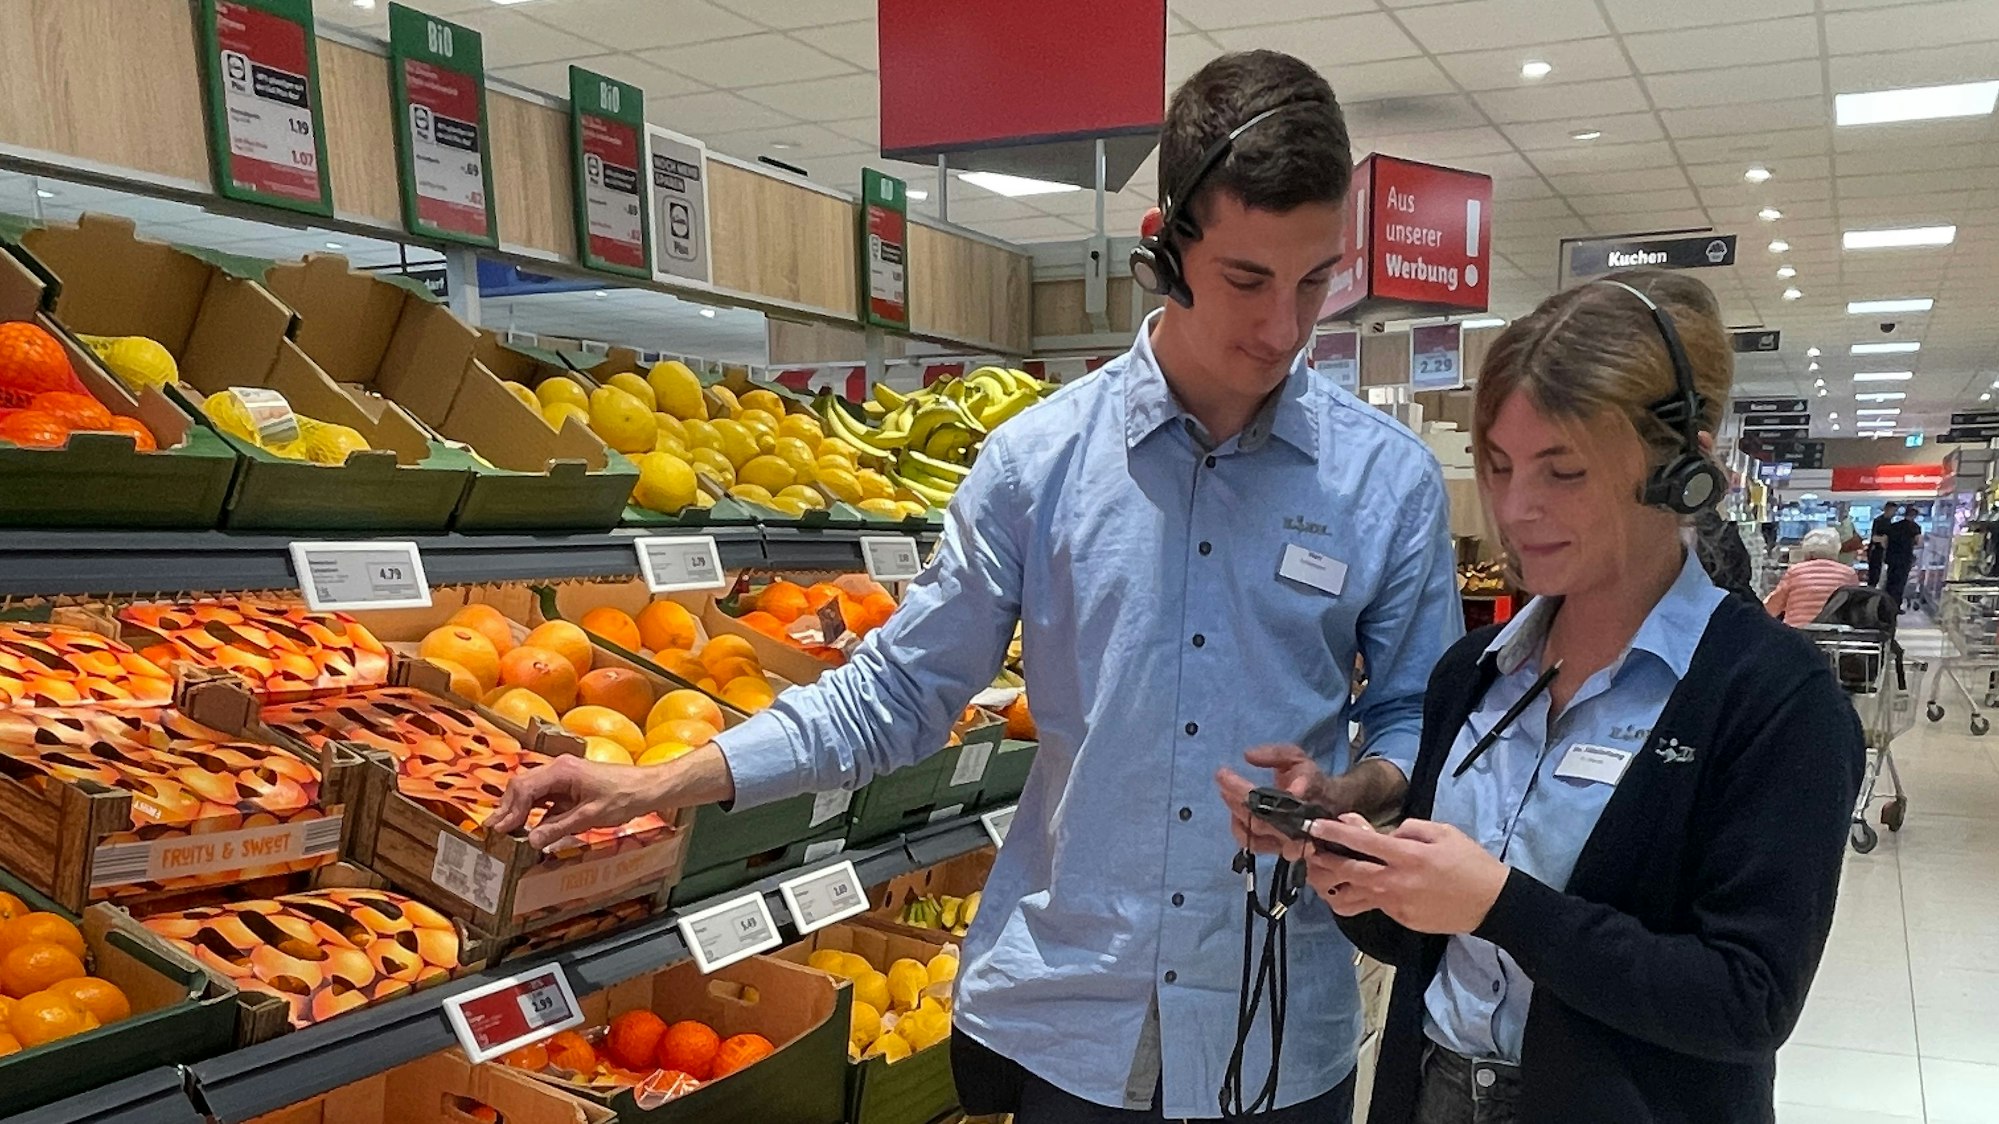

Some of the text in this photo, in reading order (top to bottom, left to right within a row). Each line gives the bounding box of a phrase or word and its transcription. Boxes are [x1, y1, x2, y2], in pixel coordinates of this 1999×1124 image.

[289, 118, 309, 135] 1.19
[1386, 186, 1415, 213] Aus
[1386, 223, 1442, 247] unserer
[1608, 249, 1667, 267] Kuchen
[1385, 253, 1458, 291] Werbung
[1420, 358, 1453, 374] 2.29
[379, 568, 402, 580] 4.79
[162, 843, 215, 869] FRUITY
[221, 841, 234, 860] &
